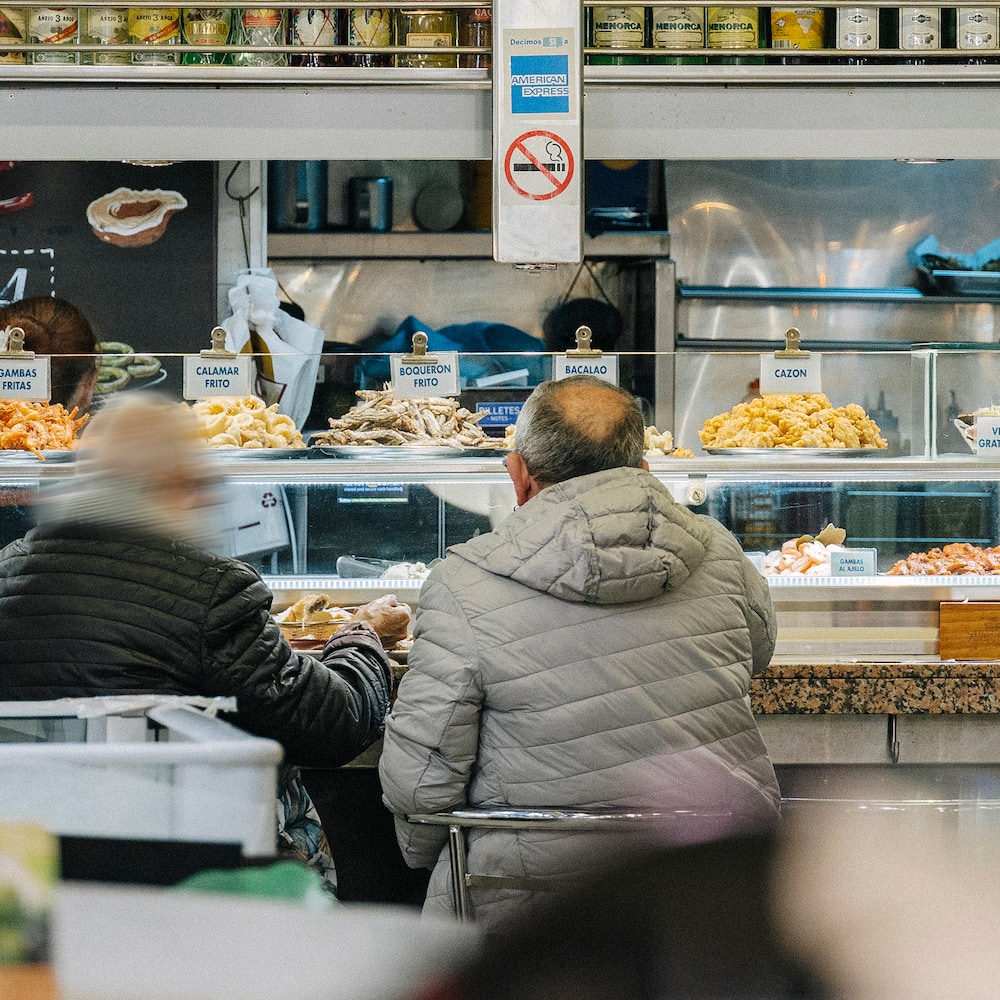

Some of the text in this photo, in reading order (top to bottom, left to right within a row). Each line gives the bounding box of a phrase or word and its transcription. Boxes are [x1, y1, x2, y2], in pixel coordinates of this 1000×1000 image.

[55, 14, 61, 23] 3
[117, 15, 123, 23] 3
[152, 13, 159, 22] 3
[595, 22, 642, 31] MENORCA
[655, 22, 702, 31] MENORCA
[708, 22, 754, 31] MENORCA
[511, 75, 565, 83] AMERICAN
[523, 87, 569, 95] EXPRESS
[0, 369, 37, 378] GAMBAS
[196, 366, 239, 376] CALAMAR
[399, 364, 451, 376] BOQUERON
[565, 365, 607, 375] BACALAO
[774, 368, 807, 378] CAZON
[2, 381, 32, 390] FRITAS
[205, 379, 230, 388] FRITO
[413, 377, 438, 388] FRITO
